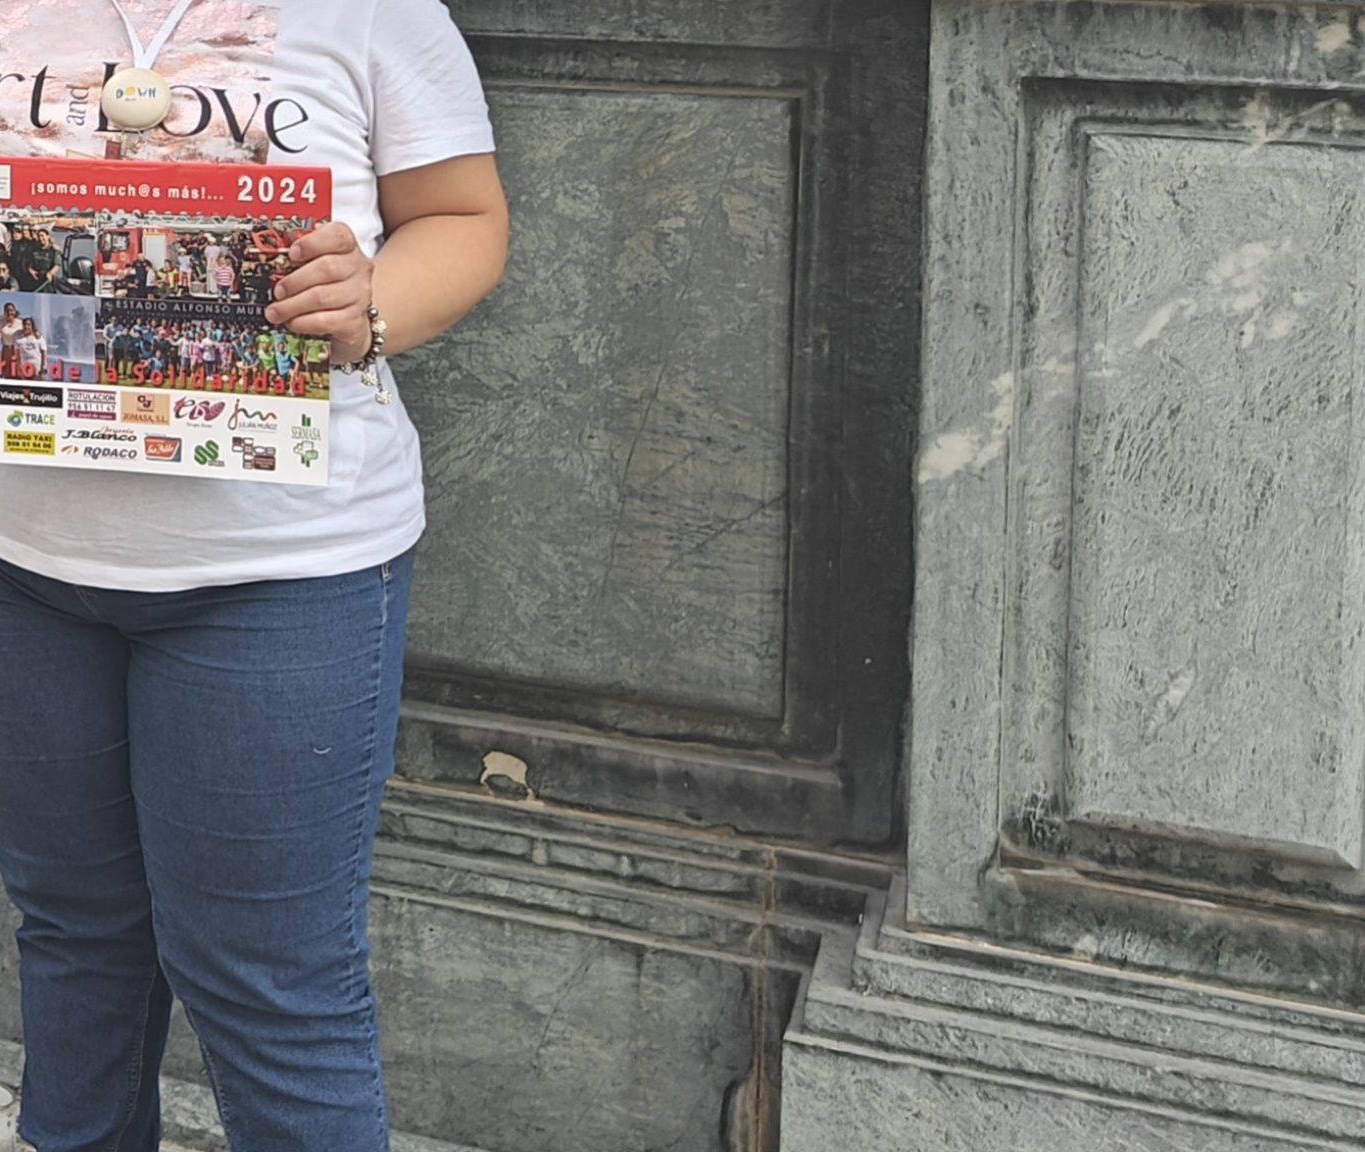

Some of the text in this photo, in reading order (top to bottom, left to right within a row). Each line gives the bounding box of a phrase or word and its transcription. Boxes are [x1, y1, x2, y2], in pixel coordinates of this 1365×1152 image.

[116, 84, 156, 99] DOWN
[66, 85, 90, 127] and
[30, 182, 87, 196] ¡somos
[95, 182, 160, 198] much@s
[237, 175, 317, 204] 2024
[116, 300, 167, 311] ESTADIO
[173, 301, 231, 314] ALFONSO
[48, 358, 82, 380] de
[95, 360, 119, 384] la
[132, 362, 307, 397] Solidaridad
[0, 390, 58, 403] Viajes Trujillo
[25, 413, 56, 425] TRACE
